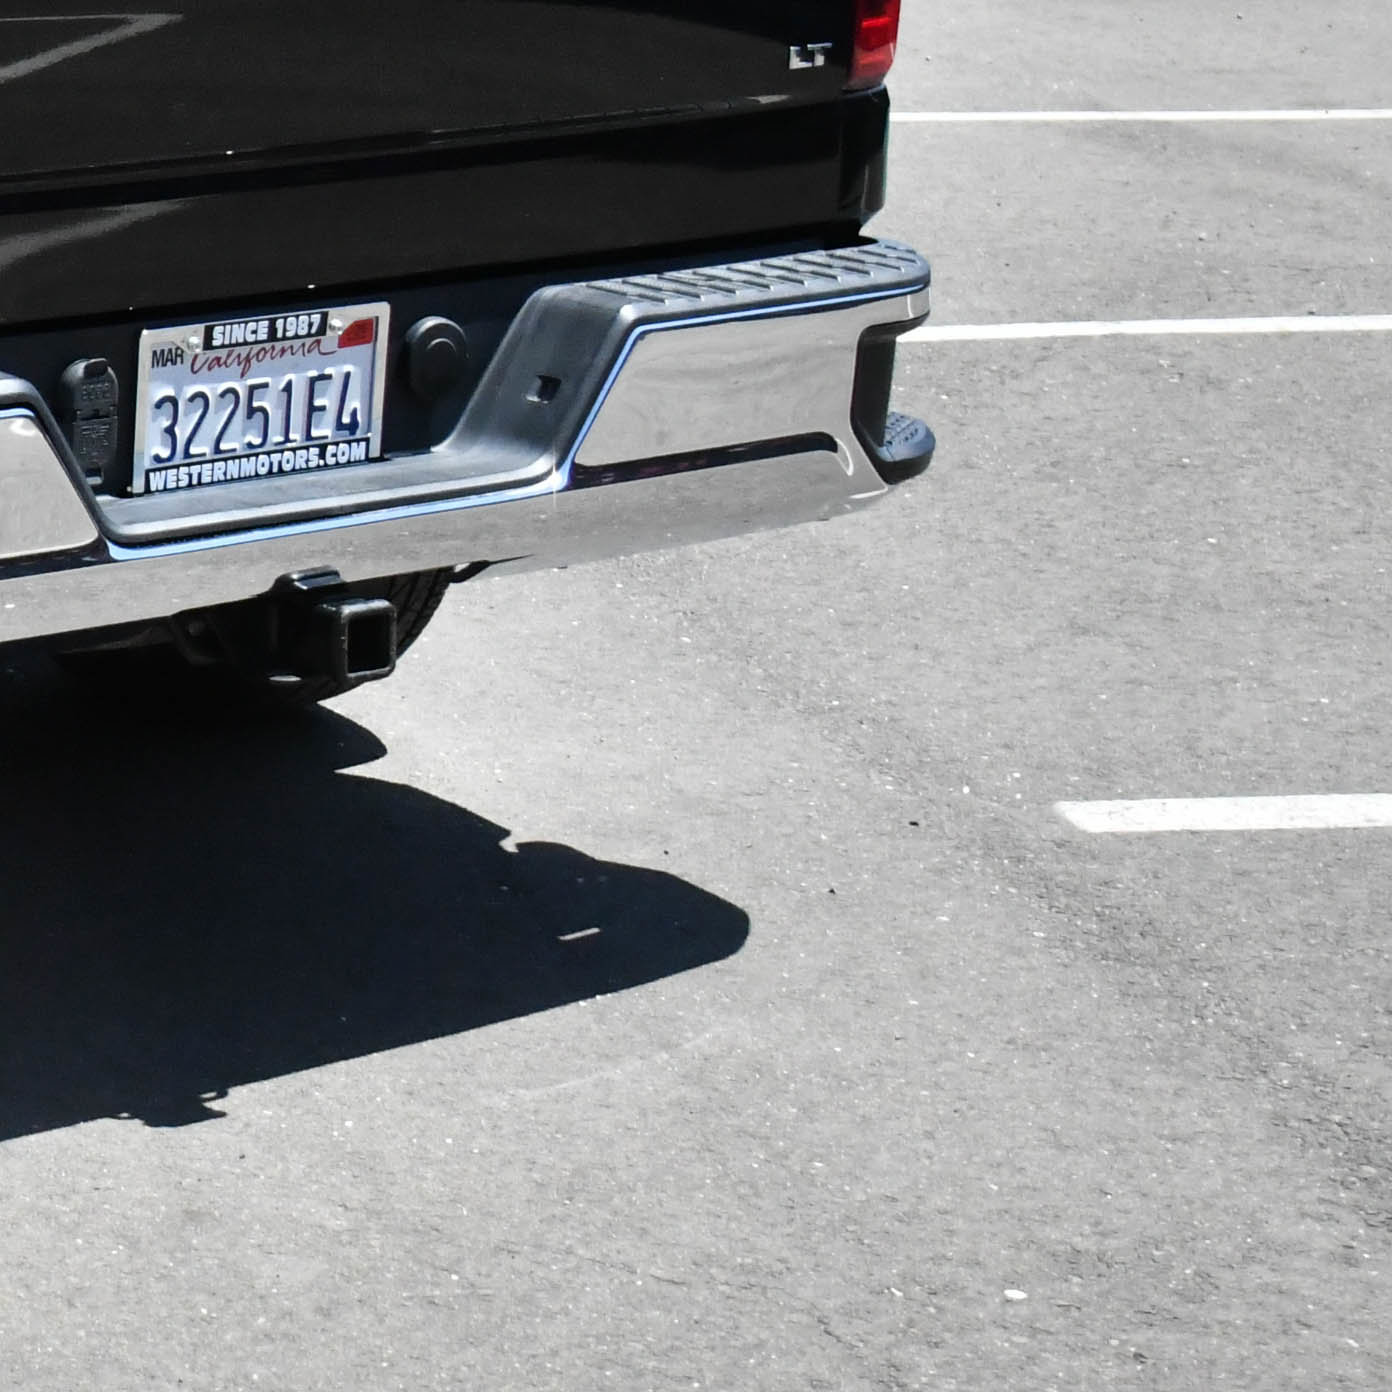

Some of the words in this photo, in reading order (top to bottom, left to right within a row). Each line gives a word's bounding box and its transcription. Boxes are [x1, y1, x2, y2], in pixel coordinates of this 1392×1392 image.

[789, 42, 833, 70] LT
[212, 320, 269, 347] SINCE
[275, 314, 322, 339] 1987
[151, 346, 185, 369] MAR
[190, 338, 337, 380] California
[152, 368, 361, 464] 32251E4
[149, 442, 366, 492] WESTERNMOTORS.COM
